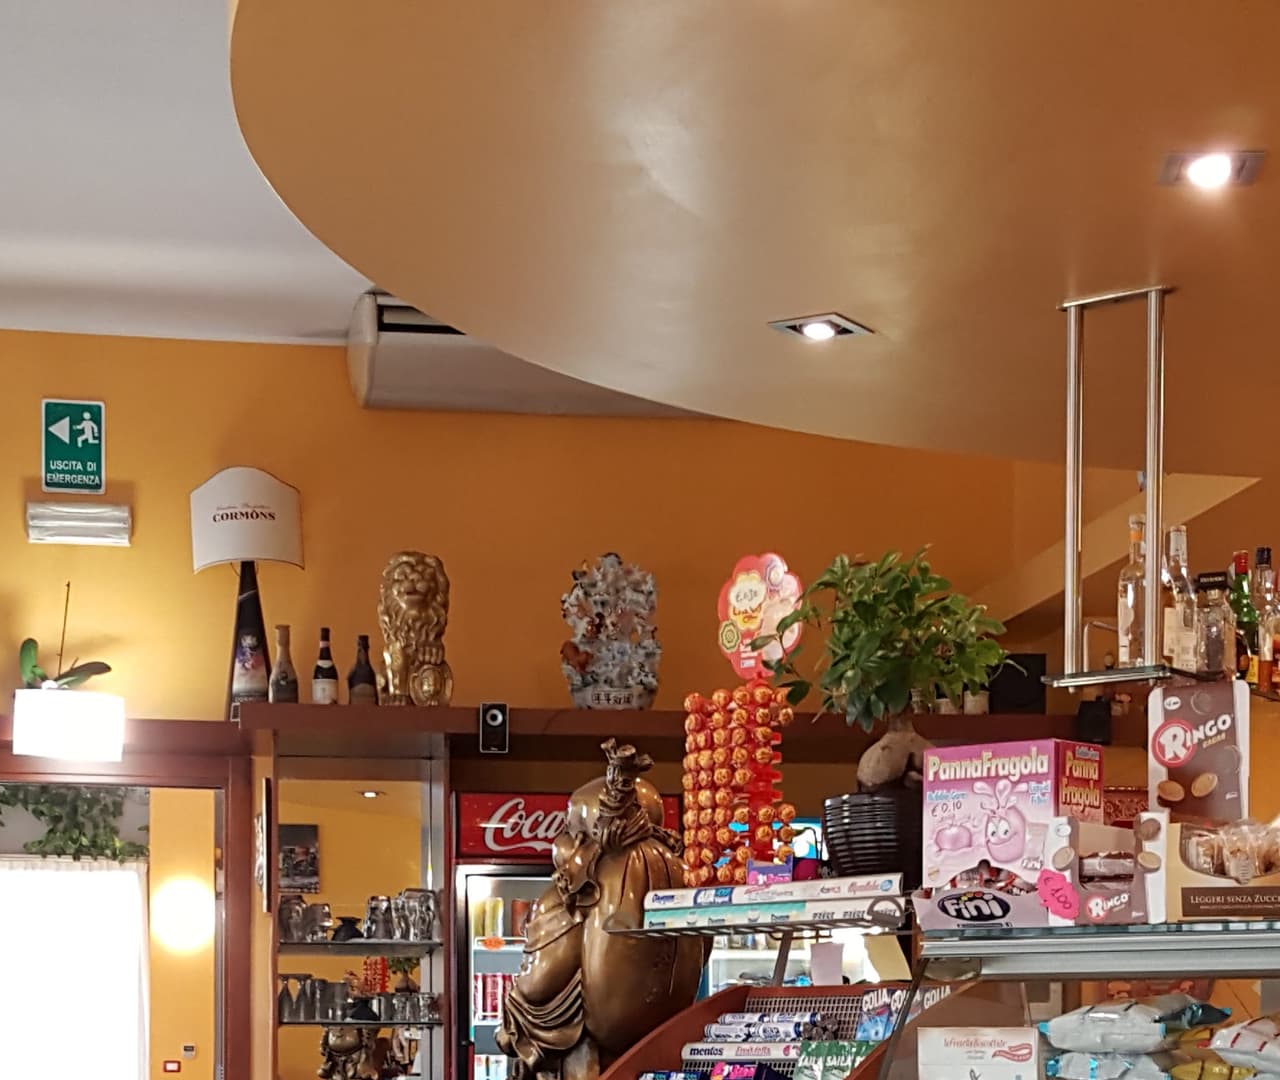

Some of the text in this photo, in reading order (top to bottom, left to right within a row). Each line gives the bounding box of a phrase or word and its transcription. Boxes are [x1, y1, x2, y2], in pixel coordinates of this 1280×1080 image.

[46, 472, 100, 485] EMERGENZA
[50, 460, 97, 472] USCITA DI
[1159, 714, 1232, 760] RINGO
[927, 747, 1049, 782] PannaFragola
[1065, 749, 1099, 781] Panna
[1062, 776, 1100, 812] Fragola
[948, 893, 1004, 920] Fini
[1087, 893, 1130, 918] RINGO
[1190, 895, 1225, 904] LEGGERI
[862, 987, 891, 1012] GOLIA
[923, 985, 951, 1009] GOLIA
[689, 1046, 724, 1056] mentos
[826, 1055, 852, 1067] SAILA
